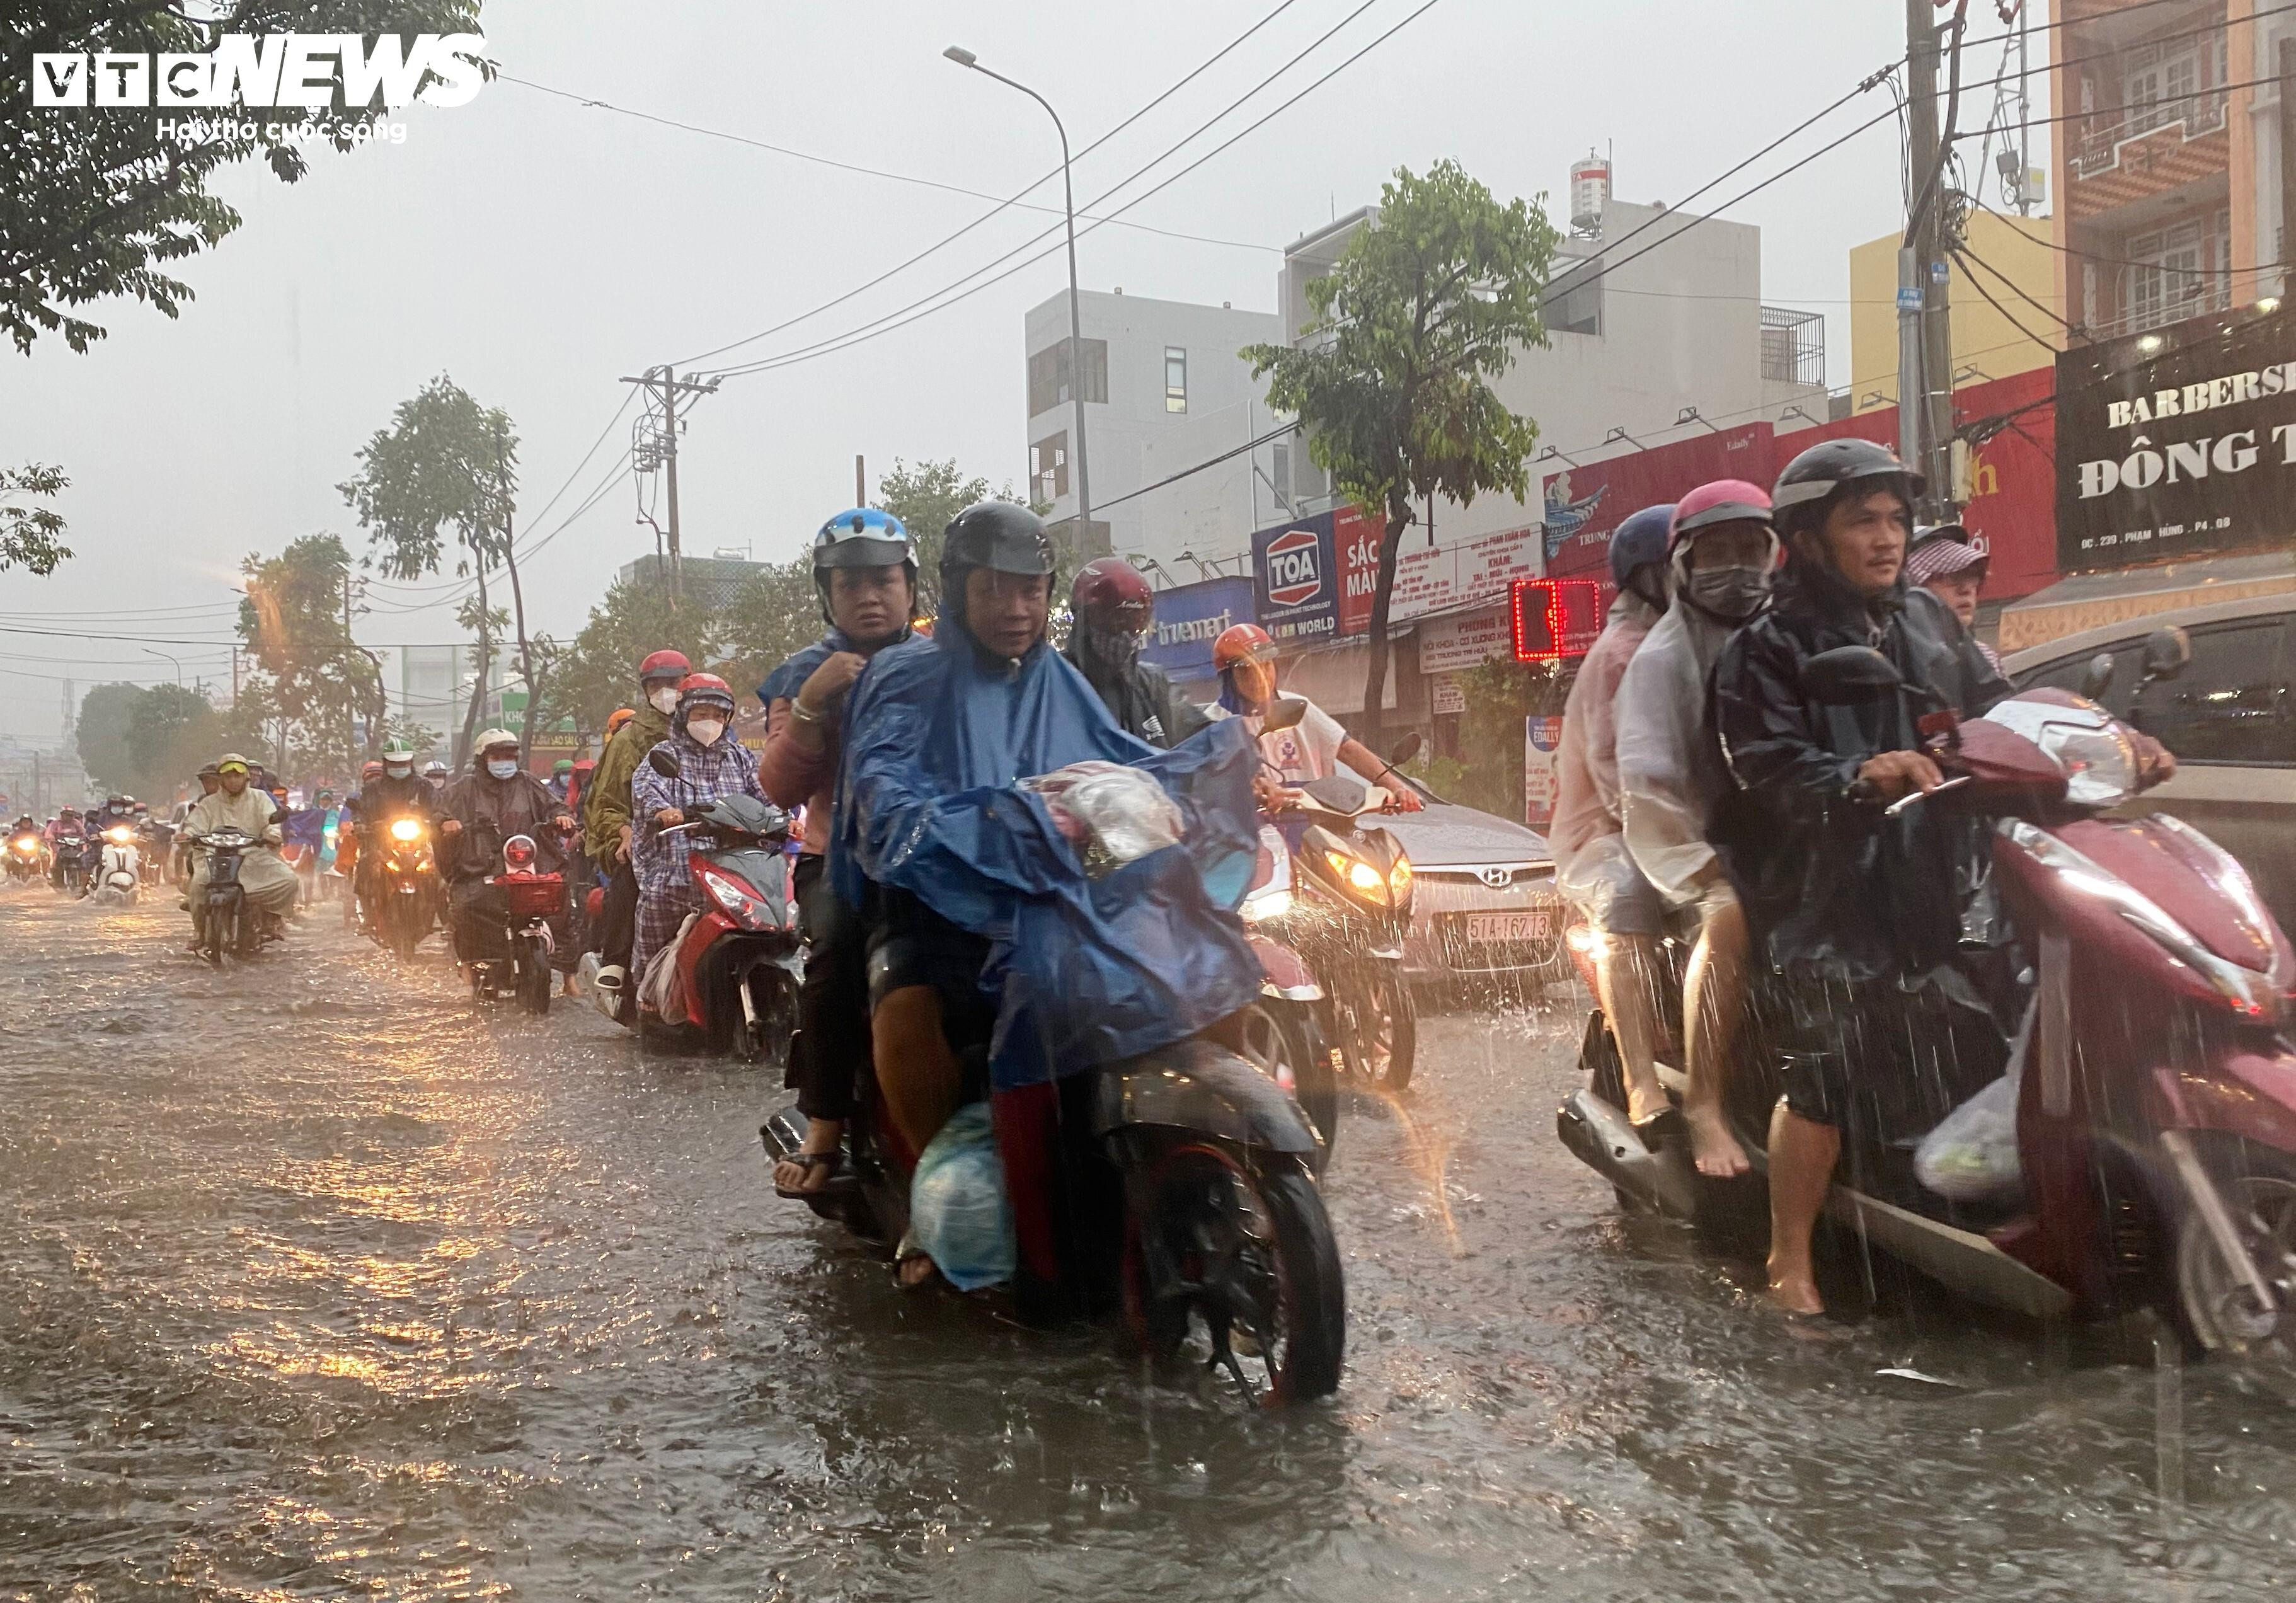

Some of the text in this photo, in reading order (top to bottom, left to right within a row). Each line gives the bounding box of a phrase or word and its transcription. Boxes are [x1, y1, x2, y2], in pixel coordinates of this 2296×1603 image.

[2078, 428, 2260, 500] ĐÔNG
[1271, 550, 1316, 586] TOA
[1347, 535, 1378, 568] SẮC
[1158, 608, 1231, 645] truemart
[1297, 616, 1335, 635] WORLD
[1534, 731, 1559, 742] EDALLY
[1469, 917, 1547, 938] 51A-167.13
